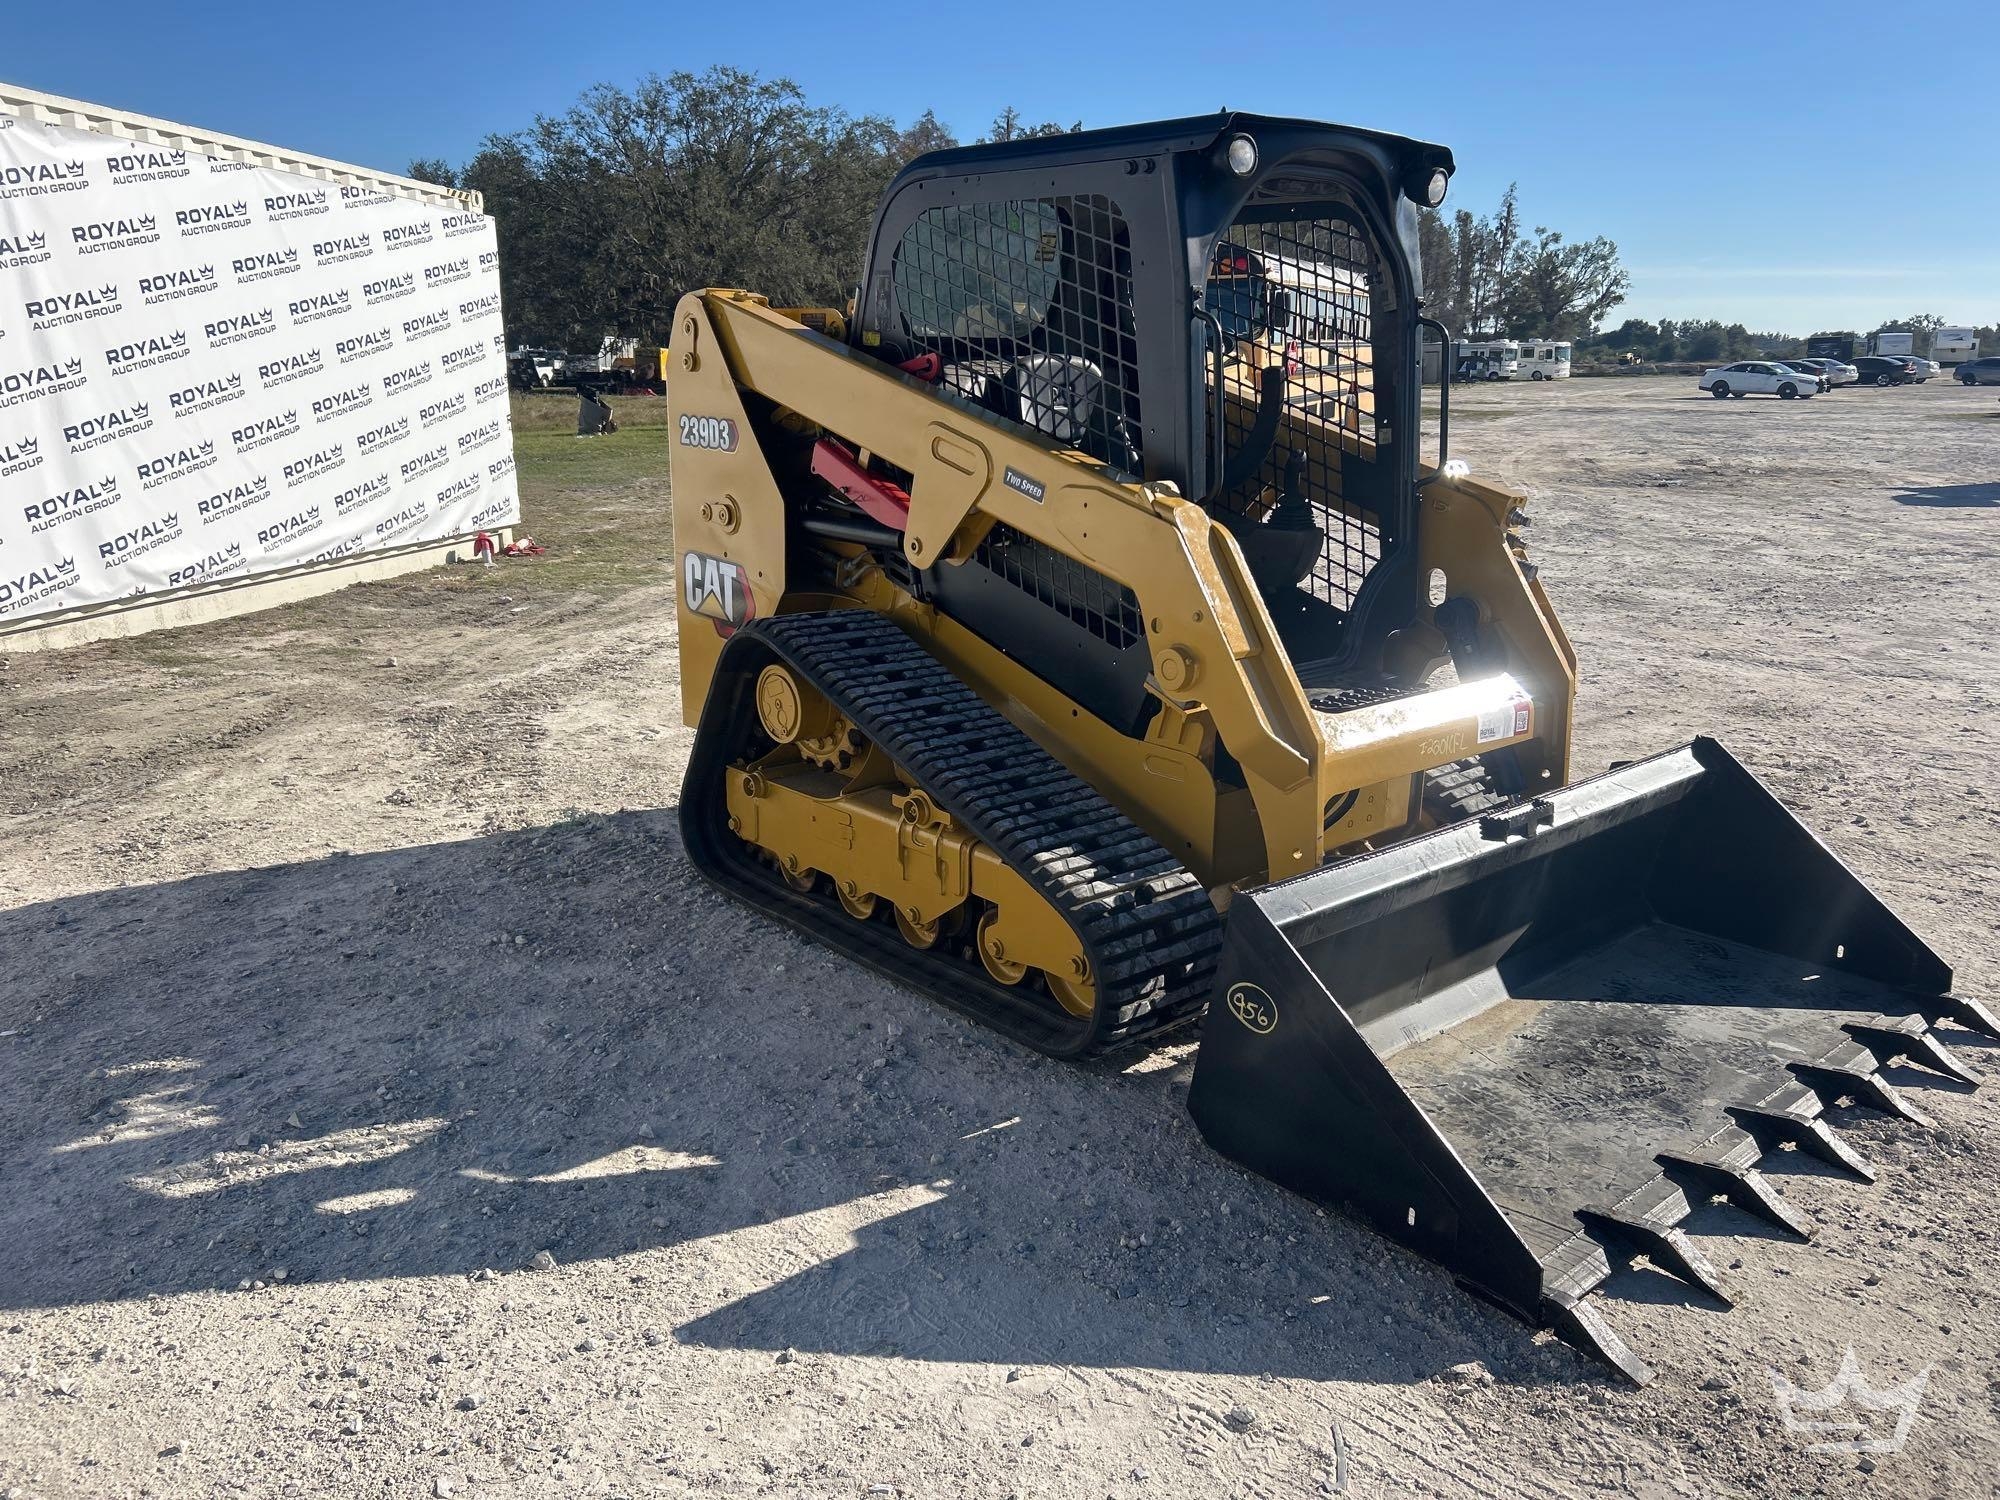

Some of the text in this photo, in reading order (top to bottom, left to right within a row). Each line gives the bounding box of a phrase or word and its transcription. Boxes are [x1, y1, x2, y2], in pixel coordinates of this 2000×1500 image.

[0, 164, 67, 186] OYAL
[106, 153, 172, 173] ROYAL
[210, 162, 248, 173] AUCTION
[113, 168, 190, 185] AUCTION GROUP
[0, 180, 89, 199] UCTION GROUP
[264, 193, 315, 211] ROYAL
[269, 205, 329, 222] AUCTION GROUP
[345, 198, 374, 209] AUCTION
[175, 204, 234, 226] ROYAL
[441, 213, 477, 229] ROYAL
[71, 219, 140, 243] ROYAL
[181, 218, 251, 237] AUCTION GROUP
[383, 224, 422, 242] ROYAL
[78, 233, 160, 255] AUCTION GROUP
[313, 237, 359, 257] ROYAL
[387, 240, 413, 251] AUCTION
[9, 252, 51, 267] GROUP
[232, 252, 286, 274] ROYAL
[317, 248, 372, 267] AUCTION GROUP
[139, 269, 201, 294] ROYAL
[237, 264, 301, 284] AUCTION GROUP
[424, 261, 461, 280] ROYAL
[145, 282, 218, 306] AUCTION GROUP
[363, 276, 404, 297] ROYAL
[26, 290, 101, 319] ROYAL
[288, 293, 337, 316] ROYAL
[367, 293, 395, 306] AUCTION
[459, 297, 492, 315] ROYAL
[33, 303, 122, 331] AUCTION GROUP
[204, 313, 260, 338] ROYAL
[293, 304, 351, 326] AUCTION GROUP
[403, 313, 440, 334] ROYAL
[210, 324, 276, 349] AUCTION GROUP
[336, 332, 380, 355] ROYAL
[105, 336, 172, 365] ROYAL
[112, 348, 190, 376] AUCTION GROUP
[340, 342, 393, 364] AUCTION GROUP
[441, 345, 476, 366] ROYAL
[258, 354, 309, 380] ROYAL
[263, 363, 324, 390] AUCTION GROUP
[383, 366, 422, 389] ROYAL
[0, 365, 67, 394] OYAL
[47, 376, 87, 394] GROUP
[386, 382, 413, 398] AUCTION
[474, 376, 505, 397] ROYAL
[169, 379, 228, 408] ROYAL
[175, 389, 245, 419] AUCTION GROUP
[312, 389, 359, 415] ROYAL
[316, 398, 372, 424] AUCTION GROUP
[419, 398, 456, 421] ROYAL
[63, 409, 133, 442] ROYAL
[70, 420, 153, 454] AUCTION GROUP
[232, 416, 285, 445] ROYAL
[357, 422, 399, 448] ROYAL
[458, 426, 490, 448] ROYAL
[680, 415, 730, 450] 239D3
[237, 424, 300, 455] AUCTION GROUP
[361, 439, 389, 456] AUCTION
[2, 456, 44, 477] GROUP
[137, 447, 200, 480] ROYAL
[143, 456, 218, 491] AUCTION GROUP
[283, 450, 332, 479] ROYAL
[288, 458, 345, 488] AUCTION GROUP
[400, 451, 438, 476] ROYAL
[488, 456, 513, 476] ROYA
[197, 483, 254, 516] ROYAL
[334, 480, 378, 508] ROYAL
[338, 486, 391, 516] AUCTION GROUP
[437, 478, 471, 504] ROYAL
[24, 484, 101, 523] ROYAL
[31, 493, 121, 534] AUCTION GROUP
[203, 490, 270, 526] AUCTION GROUP
[472, 502, 504, 526] ROYAL
[257, 513, 308, 544] ROYAL
[376, 508, 416, 535] ROYAL
[406, 514, 428, 529] GROUP
[98, 522, 164, 559] ROYAL
[264, 519, 323, 554] AUCTION GROUP
[105, 528, 183, 570] AUCTION GROUP
[168, 552, 228, 587] ROYAL
[215, 558, 246, 576] GROUP
[0, 568, 58, 602] OYAL
[0, 574, 80, 614] CTION GROUP
[685, 553, 737, 622] CAT
